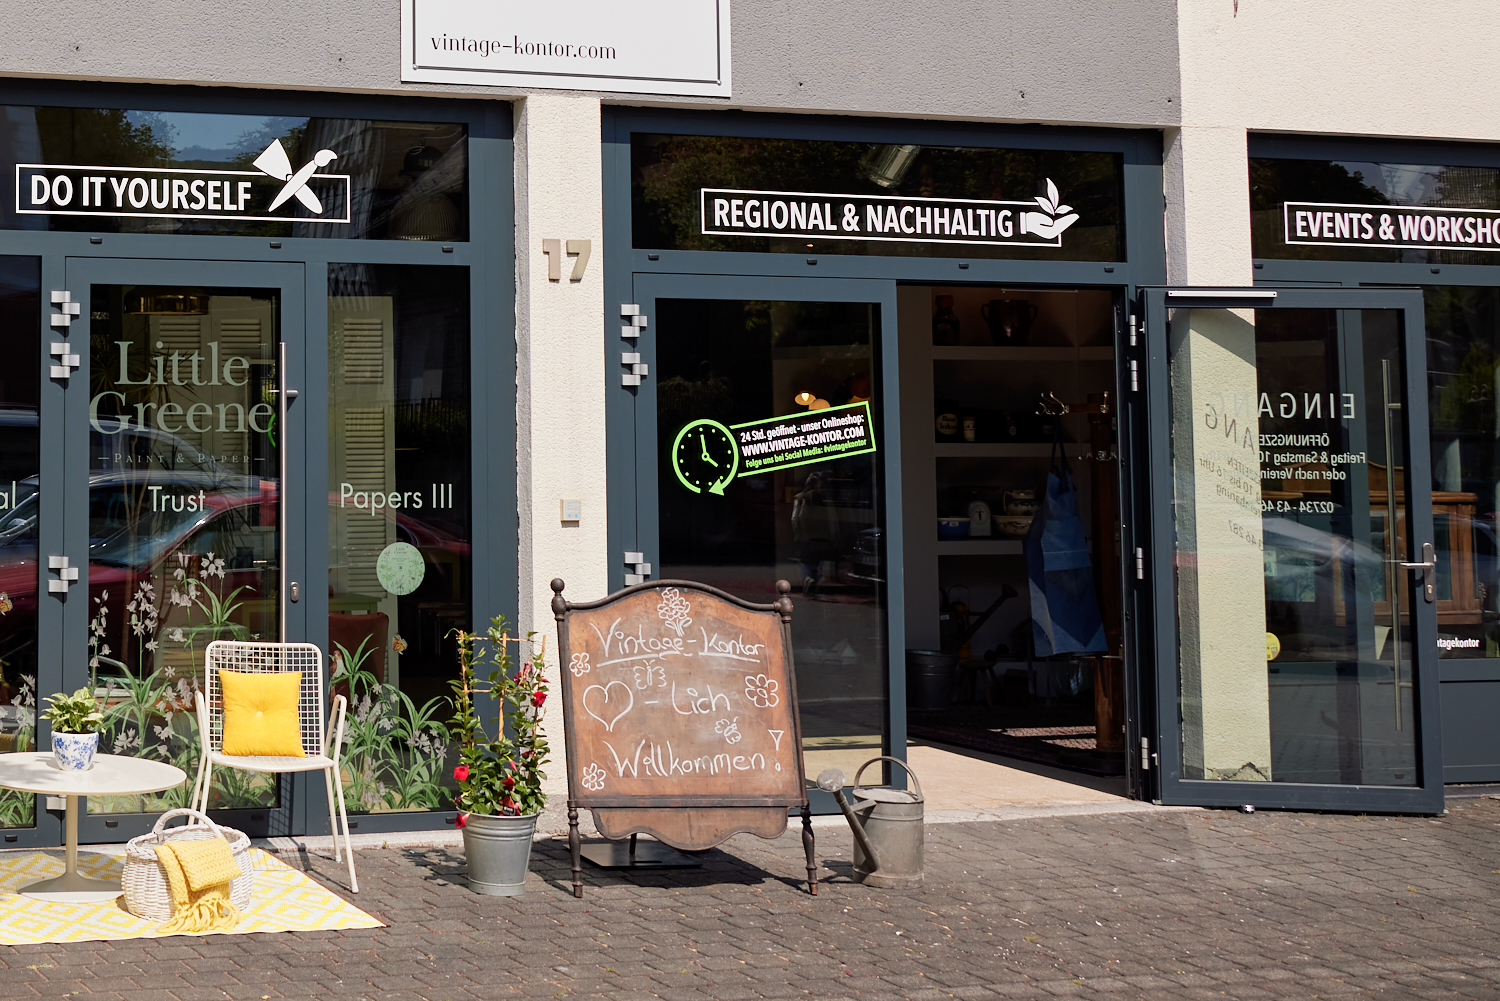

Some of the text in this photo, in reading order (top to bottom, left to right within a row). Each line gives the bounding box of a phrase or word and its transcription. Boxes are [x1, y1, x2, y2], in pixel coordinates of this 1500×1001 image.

[430, 33, 617, 60] vintage-kontor.com
[31, 174, 252, 211] DO IT YOURSELF
[714, 198, 1013, 238] REGIONAL & NACHHALTIG
[1295, 210, 1374, 240] EVENTS
[1379, 213, 1396, 240] &
[542, 238, 591, 283] 17
[113, 341, 250, 386] Little
[89, 391, 274, 434] Greene
[740, 431, 752, 443] 24
[752, 429, 767, 441] Std.
[766, 424, 797, 439] geöffnet
[801, 421, 822, 433] unser
[821, 414, 865, 428] Onlineshop:
[741, 425, 865, 457] WWW.VINTAGE-KONTOR.COM
[175, 452, 186, 464] &
[745, 458, 763, 469] Folge
[762, 456, 775, 466] uns
[774, 454, 785, 463] bei
[784, 451, 803, 462] Social
[802, 448, 824, 459] Media:
[147, 485, 206, 513] Trust
[339, 483, 423, 517] Papers
